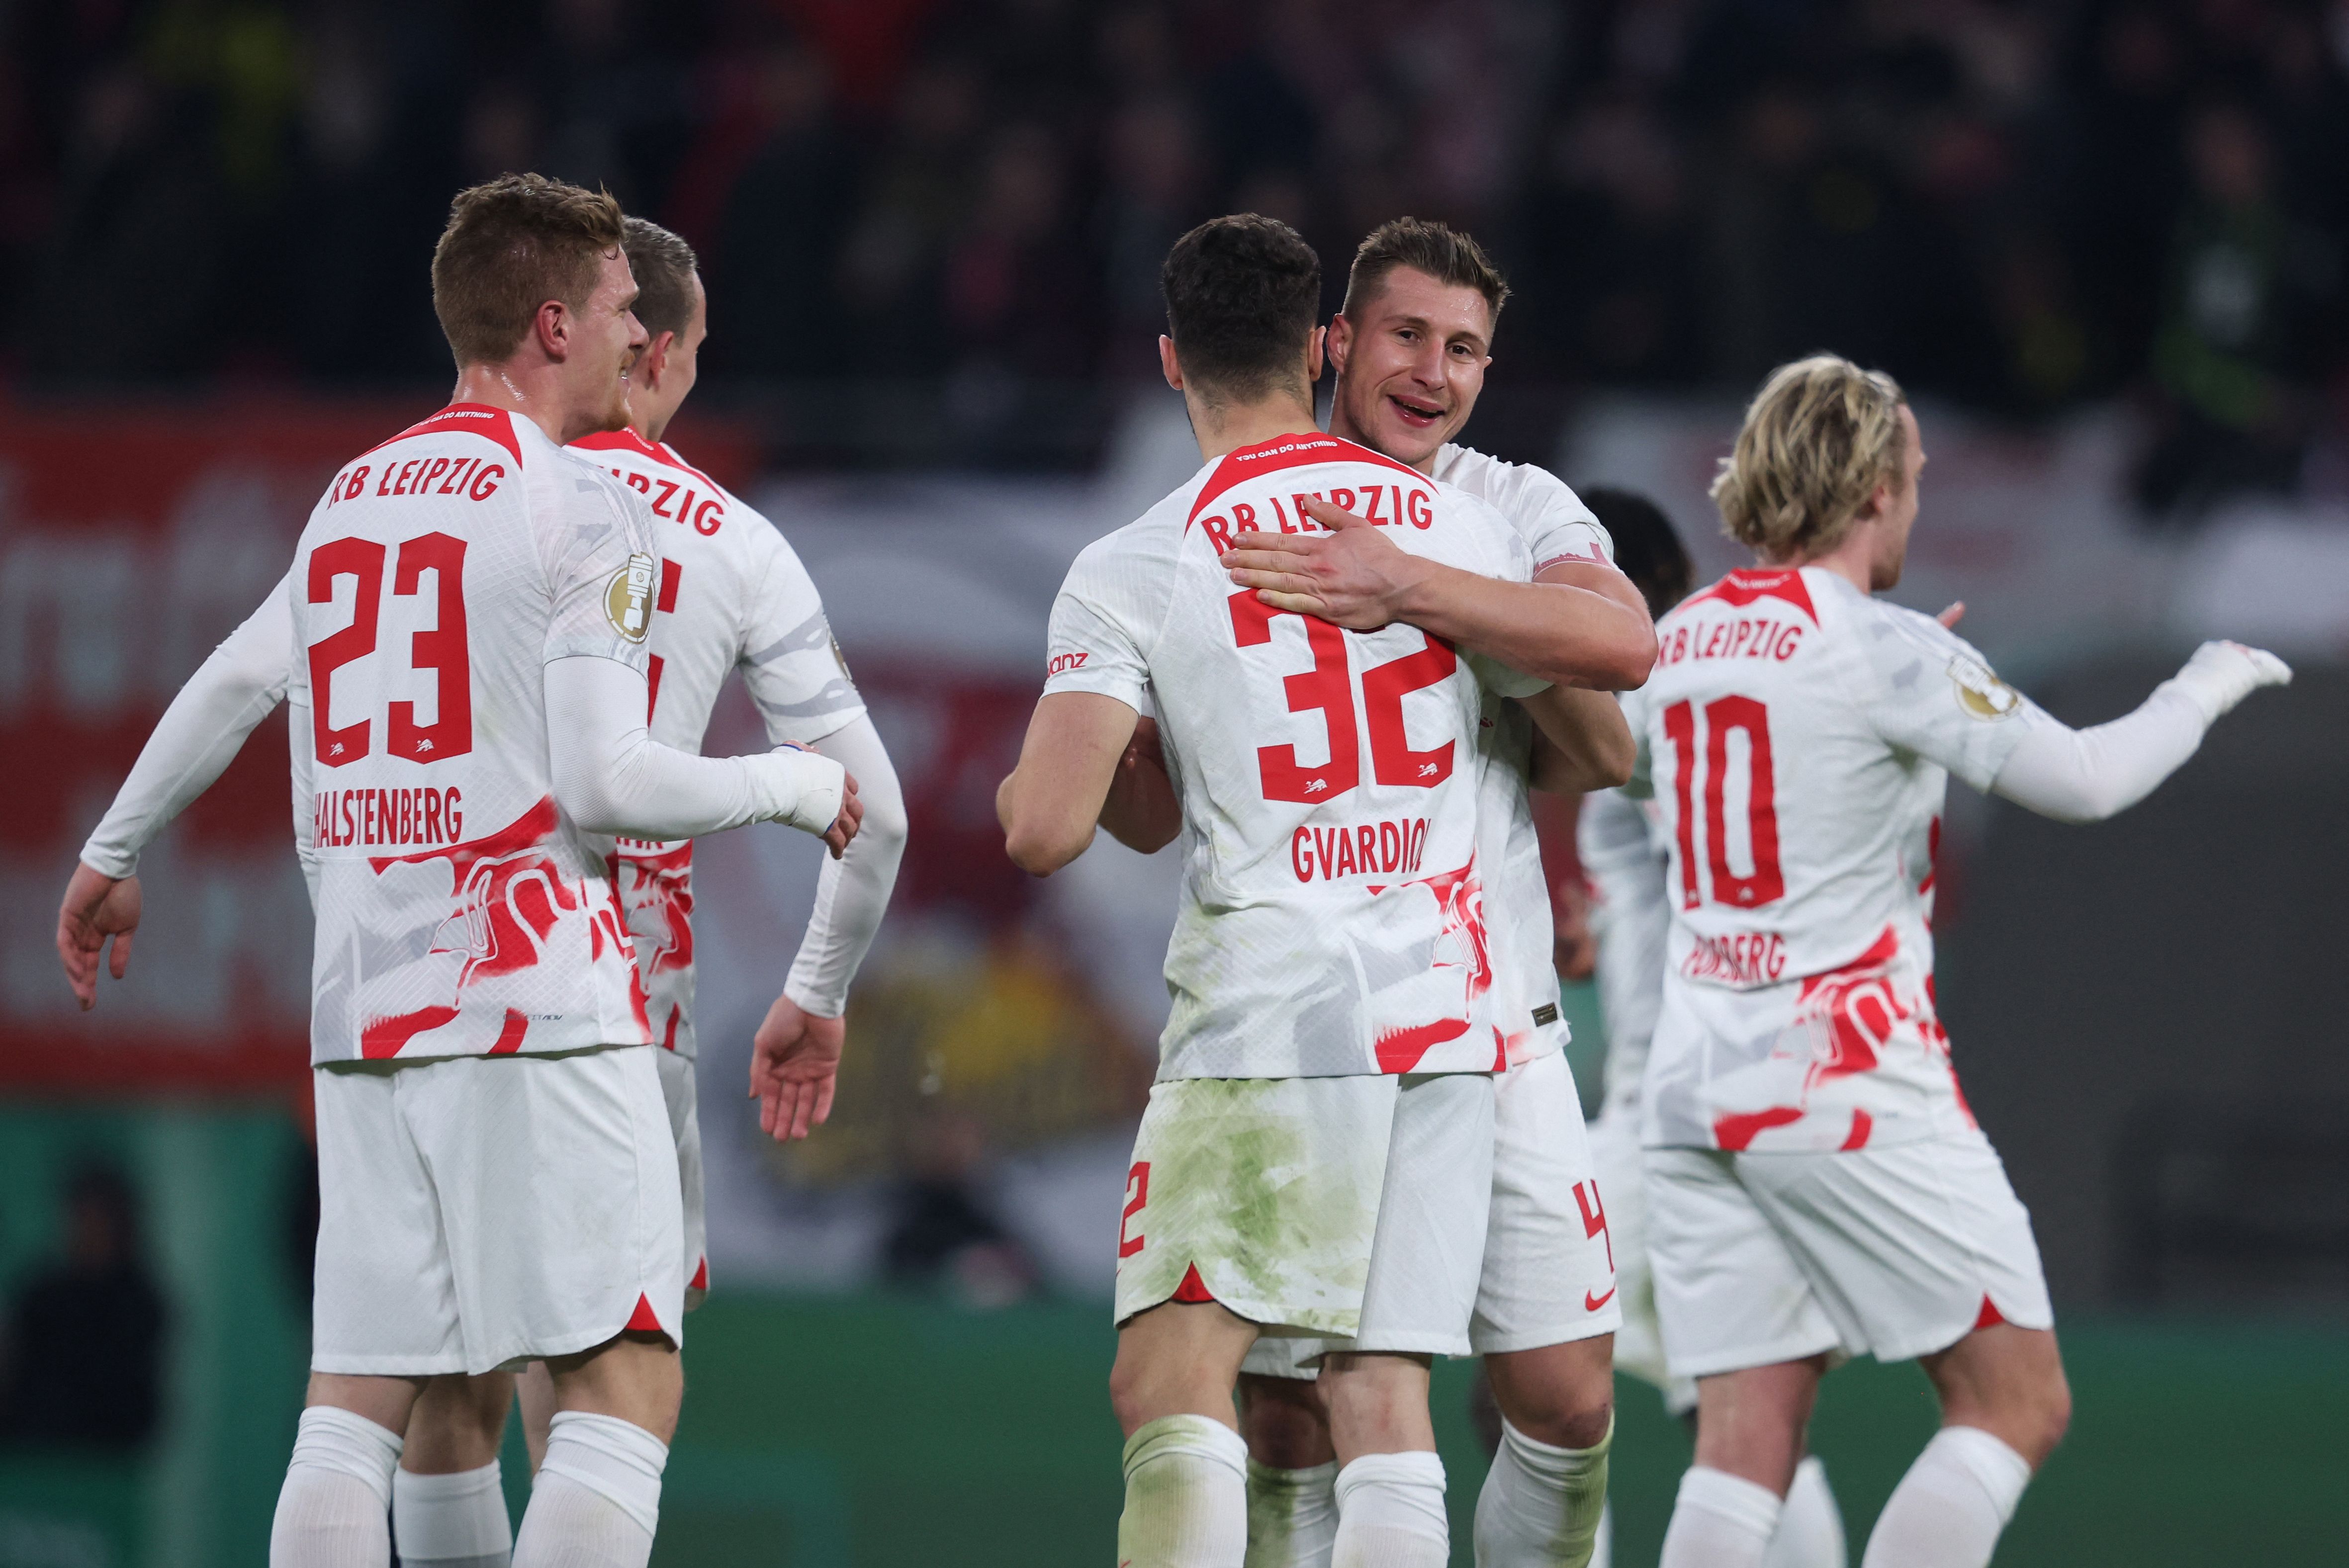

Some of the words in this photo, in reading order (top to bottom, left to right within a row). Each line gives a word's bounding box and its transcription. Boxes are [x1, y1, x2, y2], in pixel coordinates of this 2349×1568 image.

[327, 465, 370, 510] RB
[376, 458, 505, 501] LEIPZIG
[1258, 449, 1278, 457] CAN
[1279, 444, 1294, 453] DO
[1296, 440, 1338, 450] ANYTHING
[598, 465, 724, 537] PZIG
[1201, 503, 1260, 557] RB
[1269, 485, 1433, 534] LEPZIG
[308, 531, 472, 768] 23
[1655, 627, 1688, 670] RB
[1694, 620, 1802, 662] LEIPZIG
[1227, 588, 1457, 804] 32
[313, 786, 462, 849] HALSTENBERG
[1664, 695, 1785, 911] 10
[1572, 1179, 1614, 1274] 4
